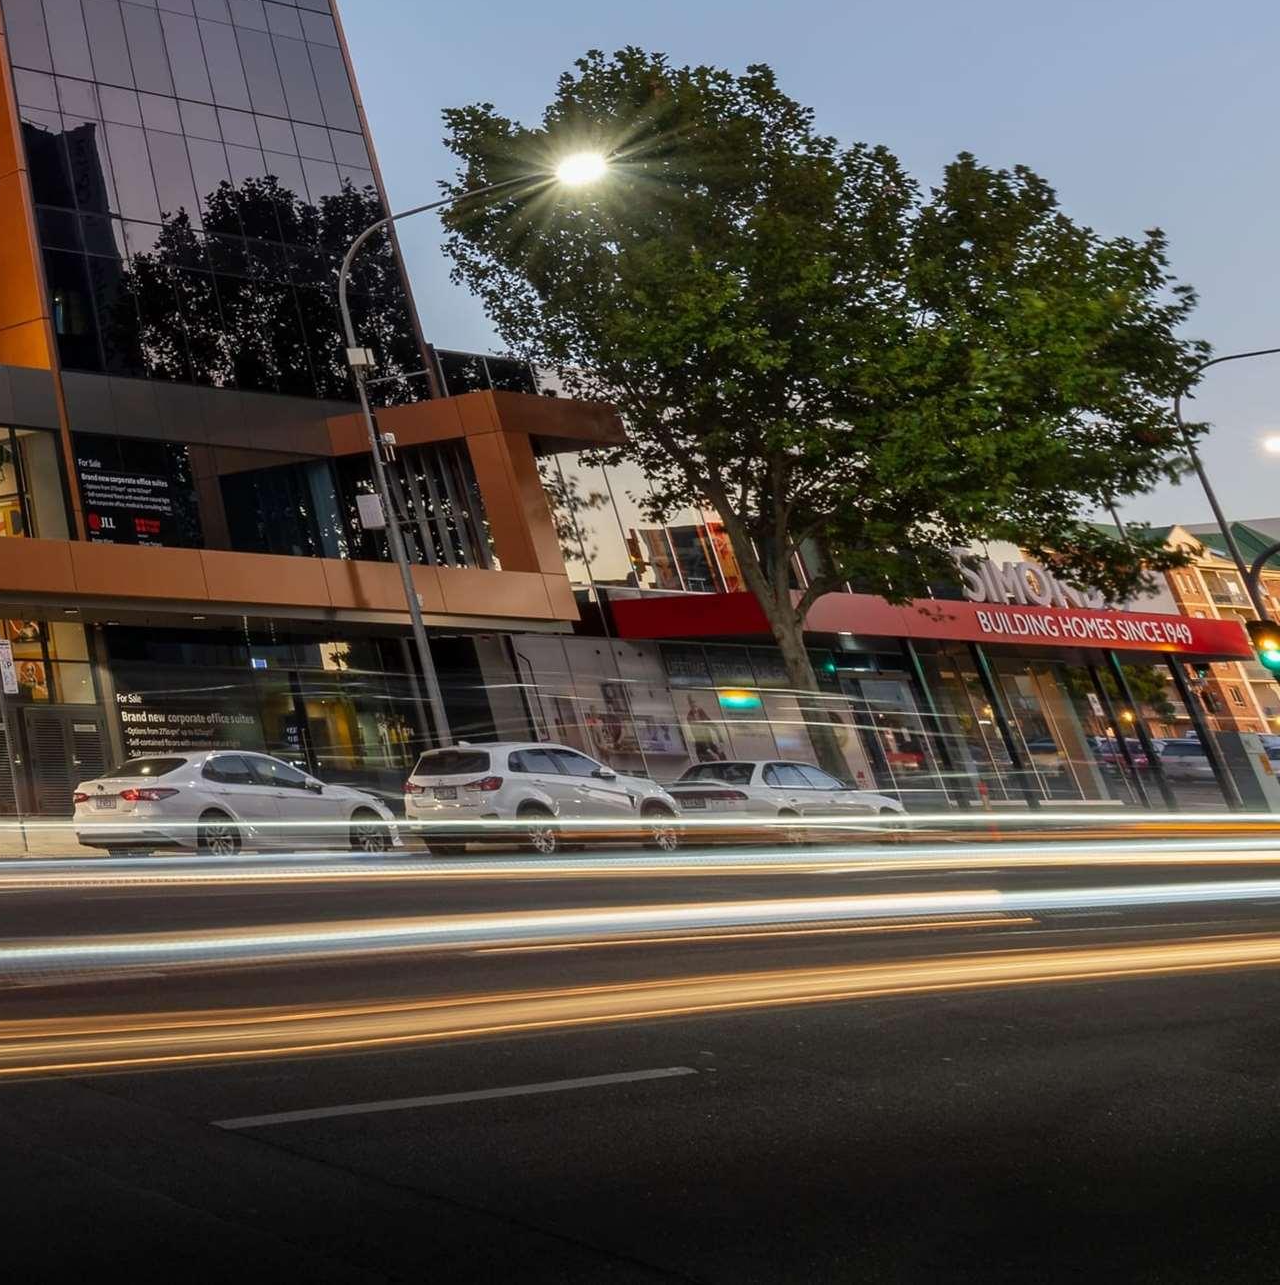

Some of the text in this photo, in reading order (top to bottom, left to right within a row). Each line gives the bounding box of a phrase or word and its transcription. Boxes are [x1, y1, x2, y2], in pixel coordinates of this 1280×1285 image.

[78, 458, 88, 467] For
[100, 517, 116, 529] JLL
[976, 610, 1193, 645] BUILDING HOMES SINCE 1949
[116, 694, 142, 703] For Sale
[121, 711, 255, 725] Brand new corporate office suites
